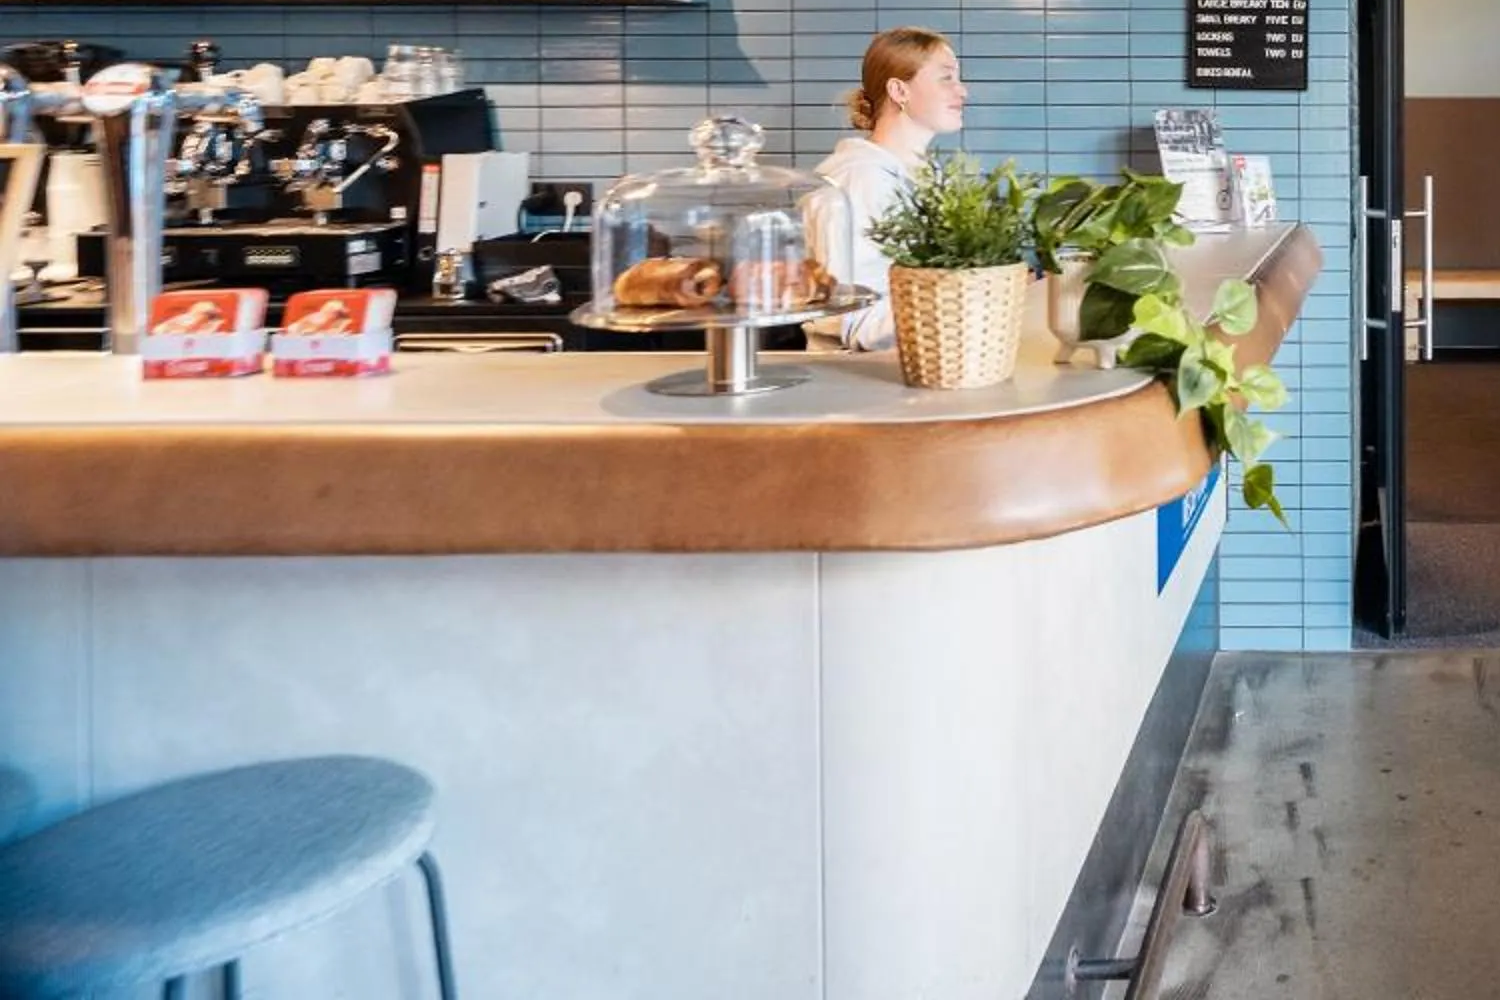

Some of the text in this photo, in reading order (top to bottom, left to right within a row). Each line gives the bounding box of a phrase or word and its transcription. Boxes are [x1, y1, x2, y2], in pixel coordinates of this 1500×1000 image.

[1197, 0, 1229, 9] LARGE
[1270, 0, 1290, 9] TEN
[1196, 14, 1222, 24] SMALL
[1265, 15, 1289, 25] FIVE
[1196, 31, 1235, 42] LOCKERS
[1265, 33, 1287, 43] TWO
[1196, 48, 1232, 57] TOWELS
[1264, 47, 1287, 58] TWO
